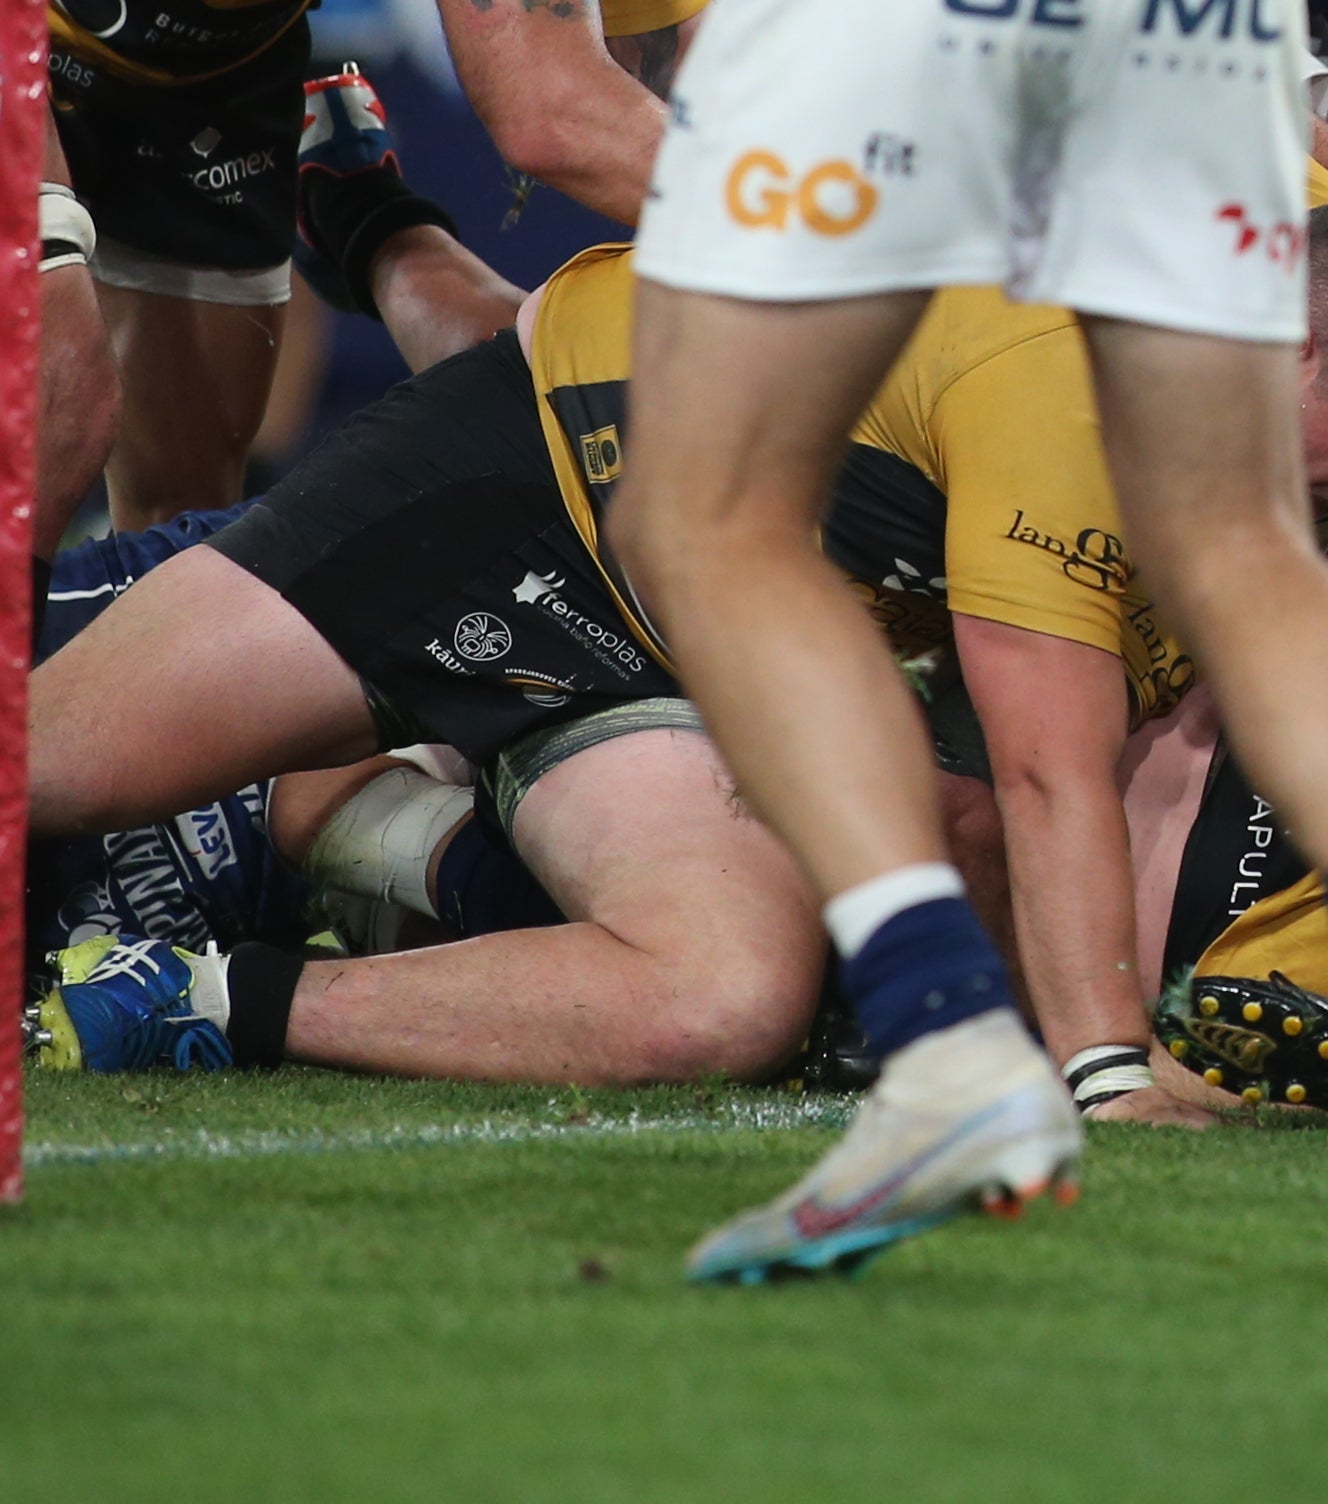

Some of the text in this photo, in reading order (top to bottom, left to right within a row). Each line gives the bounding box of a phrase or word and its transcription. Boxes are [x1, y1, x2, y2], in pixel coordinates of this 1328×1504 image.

[725, 132, 918, 239] GO fit
[541, 589, 647, 674] ferroplas
